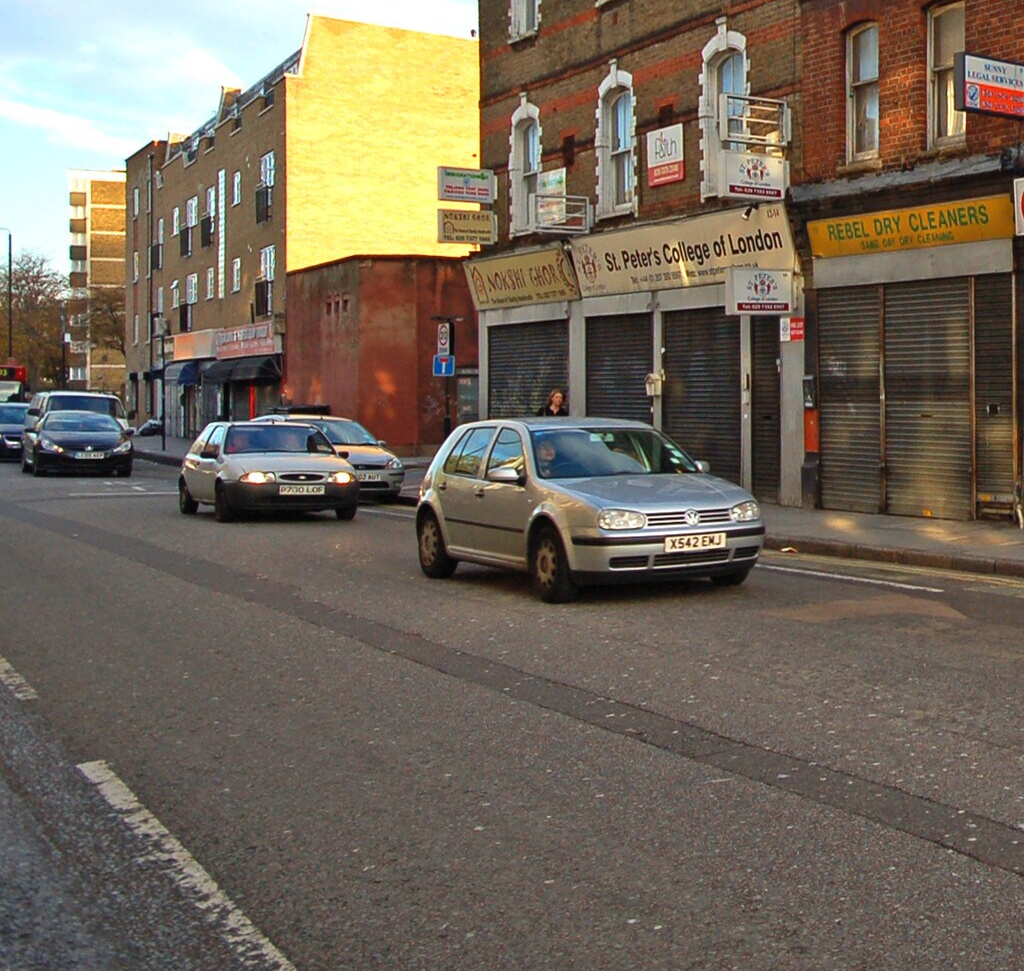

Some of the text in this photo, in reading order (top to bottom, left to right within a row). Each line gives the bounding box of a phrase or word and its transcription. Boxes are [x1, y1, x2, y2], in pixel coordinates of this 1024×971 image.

[967, 70, 1024, 87] LEGAL SERVICES
[983, 63, 1007, 75] SUNNY
[827, 205, 989, 242] REBEL DRY CLEANERS
[860, 231, 954, 250] SAME DAY DRY CLEANING
[604, 252, 621, 272] St.
[621, 247, 662, 269] Peter's
[662, 241, 711, 266] College
[713, 235, 727, 257] of
[728, 229, 783, 255] London
[487, 264, 559, 292] NOKSHI GHOR
[670, 537, 699, 549] X542
